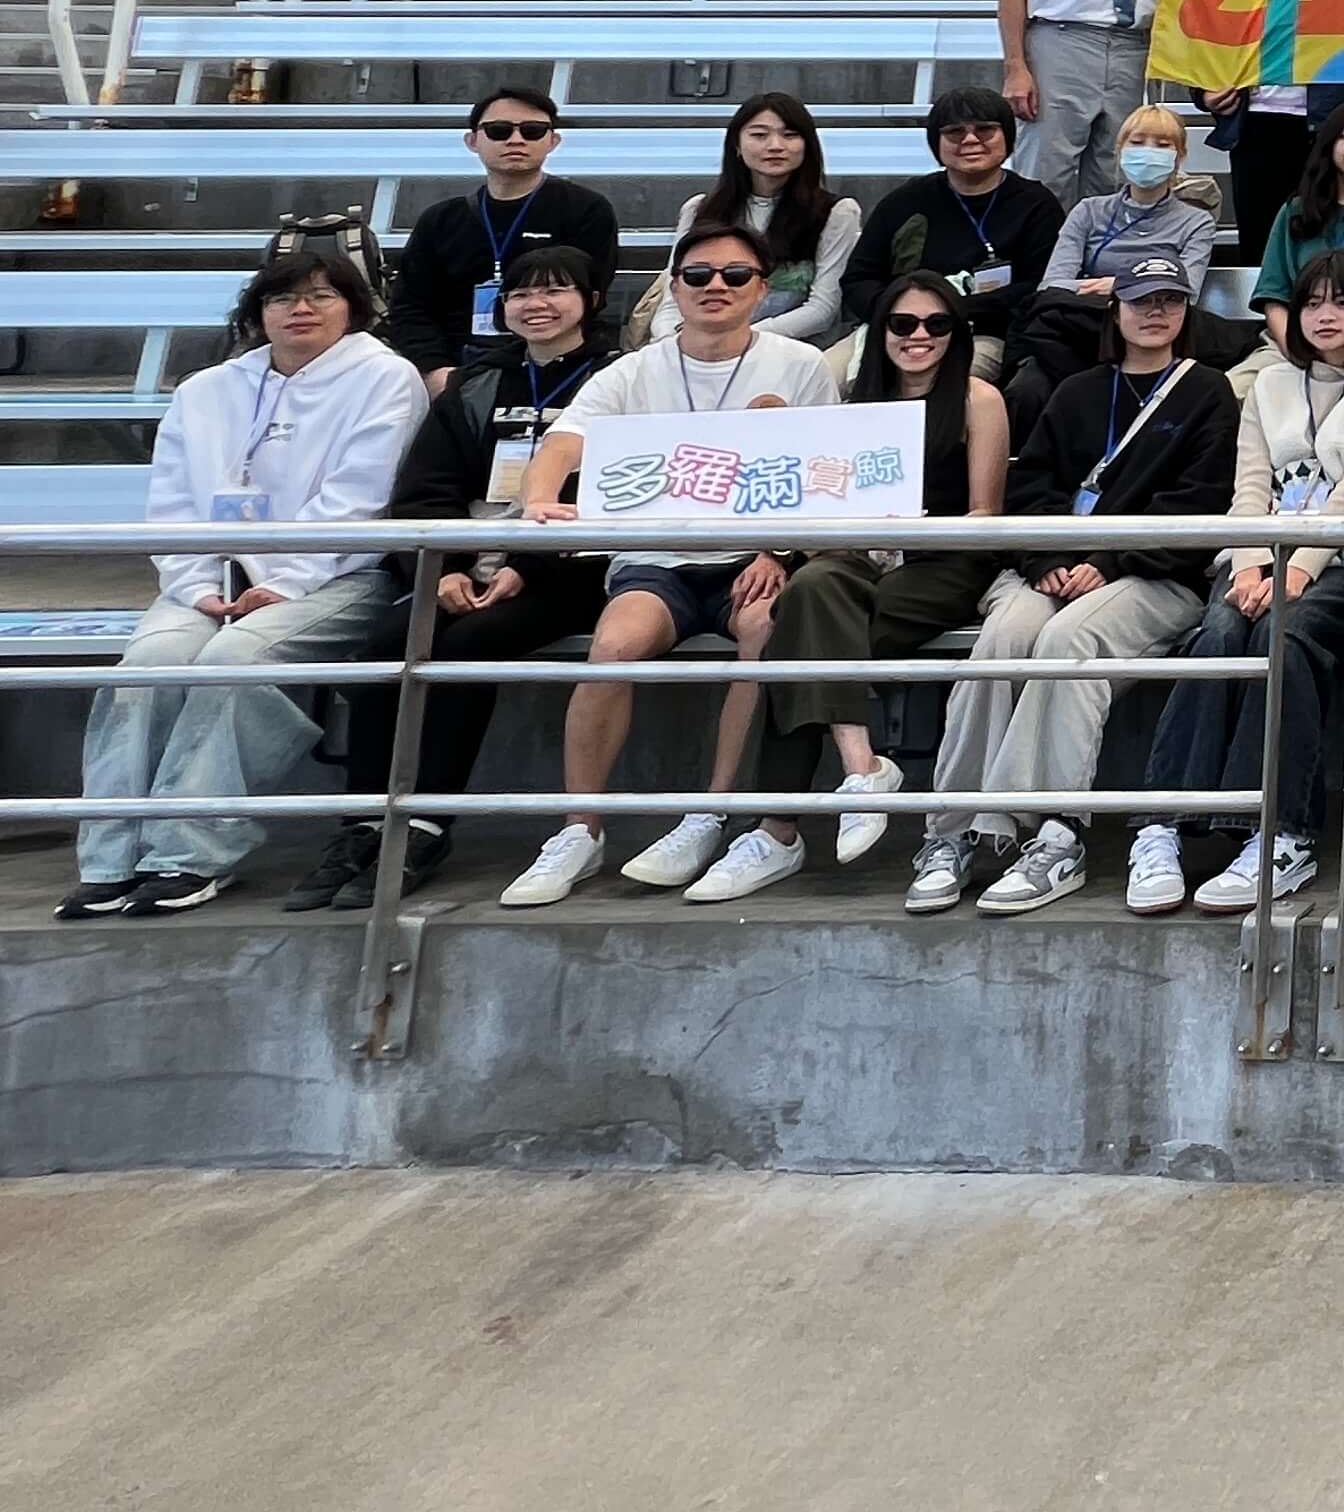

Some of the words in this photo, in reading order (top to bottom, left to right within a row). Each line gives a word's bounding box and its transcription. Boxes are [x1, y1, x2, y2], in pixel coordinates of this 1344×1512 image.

[598, 443, 904, 514] 多羅滿賞鯨
